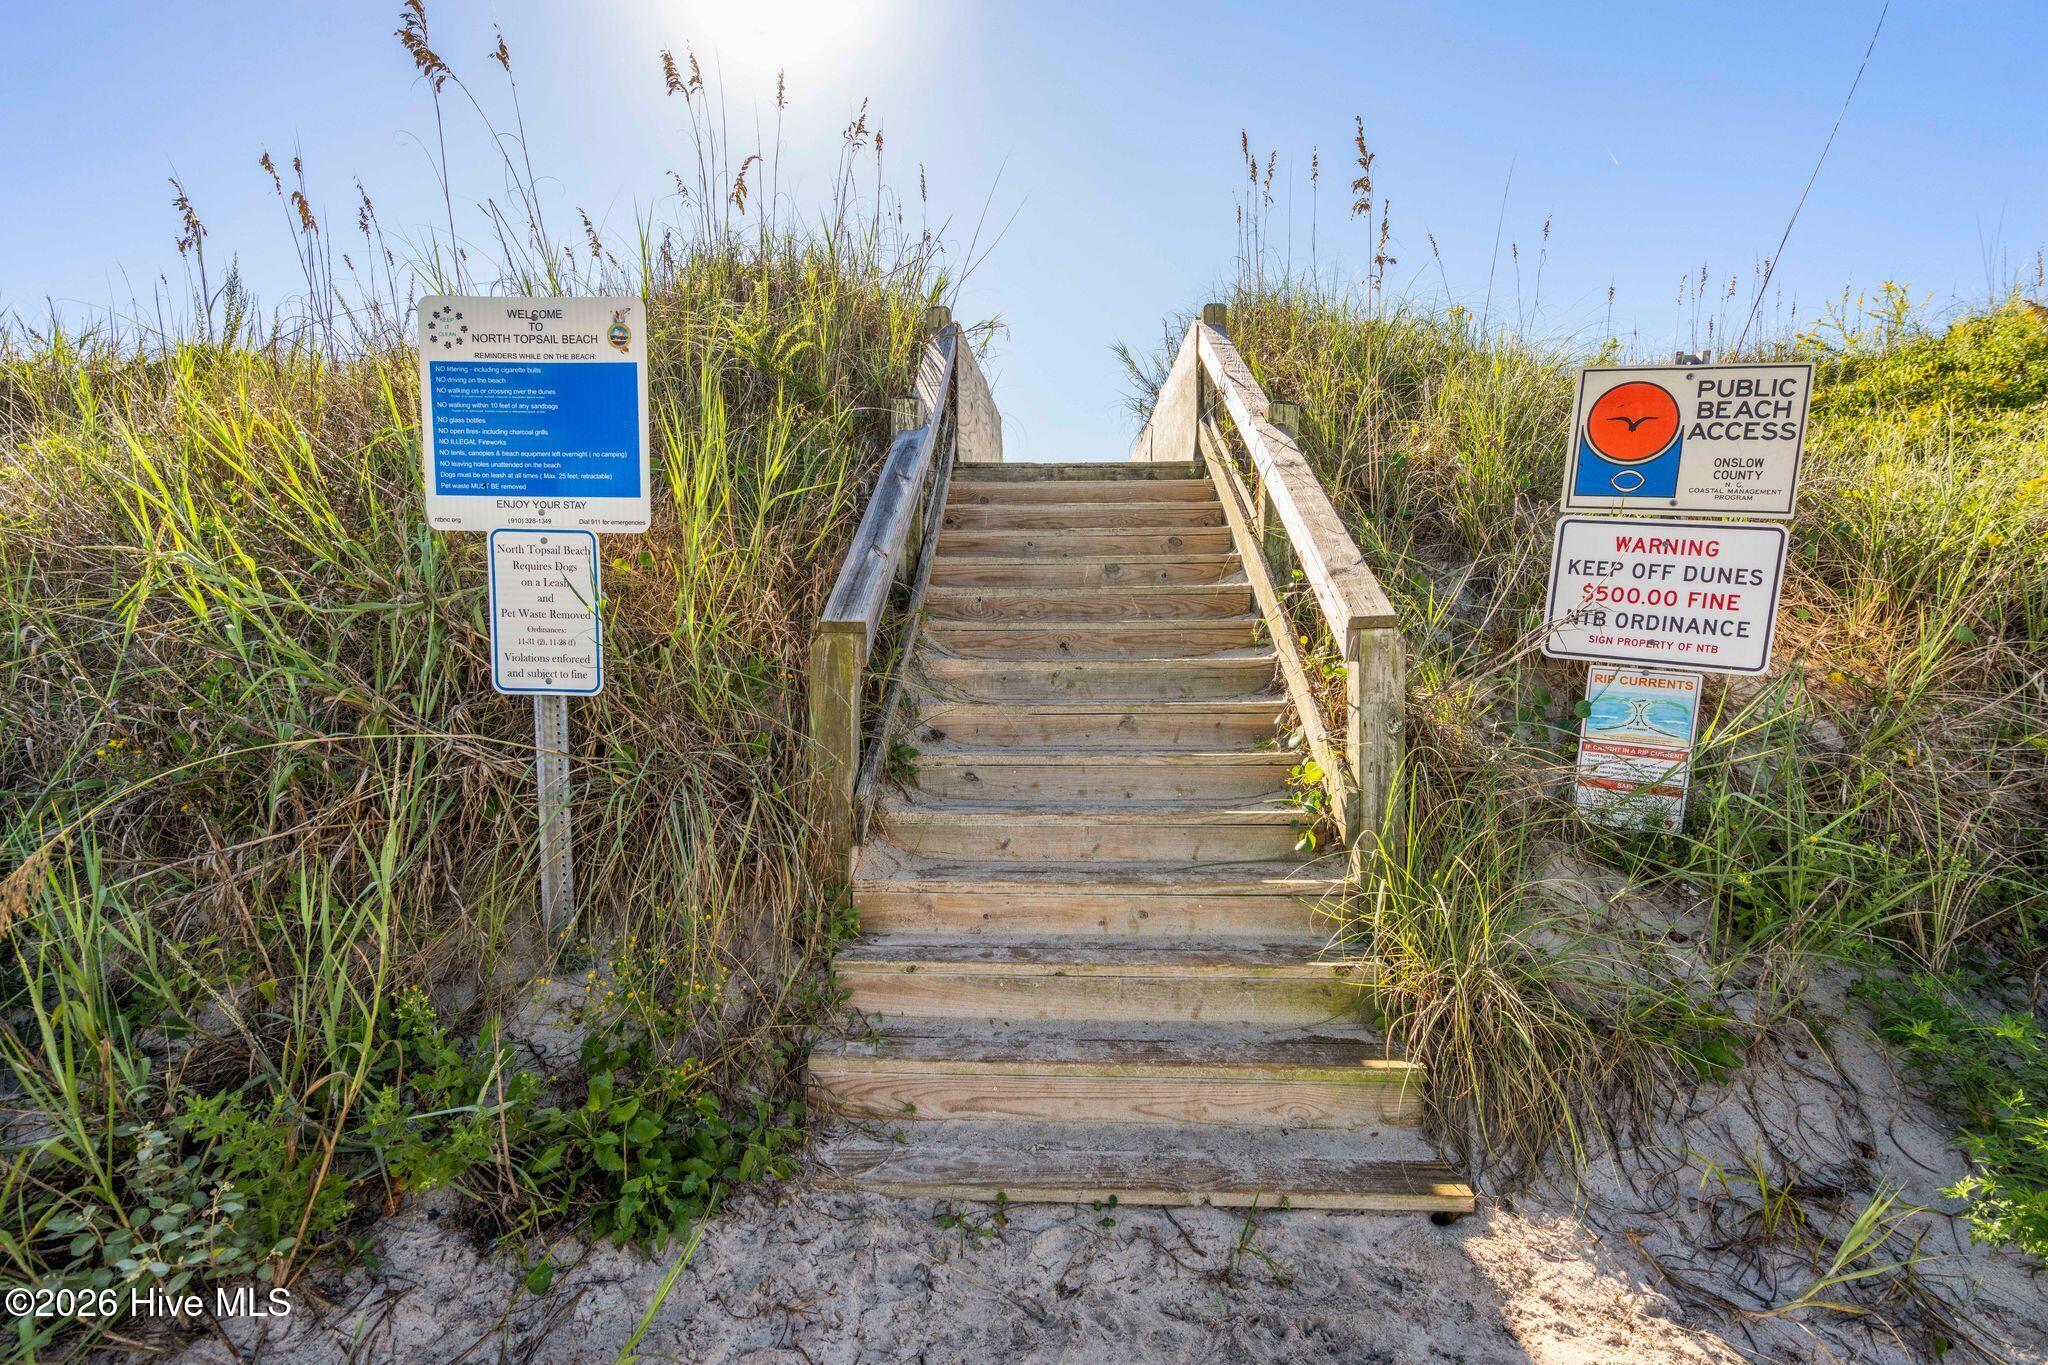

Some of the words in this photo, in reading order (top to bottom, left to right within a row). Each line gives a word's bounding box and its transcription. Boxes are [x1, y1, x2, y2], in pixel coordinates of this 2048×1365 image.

[507, 309, 562, 320] WELCOME
[529, 322, 543, 331] TO
[472, 333, 511, 343] NORTH
[513, 334, 559, 344] TOPSAIL
[562, 334, 598, 344] BEACH
[474, 352, 518, 360] REMINDERS
[474, 366, 500, 374] including
[1697, 378, 1797, 398] PUBLIC
[449, 402, 470, 410] walking
[1697, 401, 1792, 419] BEACH
[1687, 422, 1797, 441] ACCESS
[1714, 457, 1764, 468] ONSLOW
[1713, 470, 1763, 480] COUNTY
[496, 500, 530, 508] ENJOY
[533, 501, 560, 509] YOUR
[563, 501, 586, 509] STAY
[497, 544, 524, 554] North
[527, 545, 560, 556] Topsail
[564, 545, 591, 556] Beach
[1616, 536, 1720, 557] WARNING
[513, 561, 552, 572] Requires
[555, 562, 577, 572] Dogs
[1568, 559, 1624, 577] KEEP
[1632, 563, 1675, 580] OFF
[1683, 566, 1763, 586] DUNES
[544, 578, 568, 587] Leash
[538, 594, 554, 603] and
[1582, 582, 1678, 607] $500.00
[1688, 592, 1741, 611] FINE
[501, 609, 515, 618] Pet
[518, 609, 546, 619] Waste
[550, 610, 591, 620] Removed
[527, 626, 566, 634] Ordinances:
[1615, 612, 1751, 638] ORDINANCE
[1588, 635, 1613, 645] SIGN
[1617, 637, 1674, 650] PROPERTY
[1678, 643, 1693, 652] OF
[1696, 644, 1718, 654] NTB
[504, 653, 549, 663] Violations
[552, 653, 590, 664] enforced
[507, 669, 524, 678] and
[527, 669, 557, 680] subject
[571, 670, 588, 679] fine
[1594, 674, 1616, 684] RIP
[1619, 675, 1694, 691] CURRENTS
[1651, 750, 1684, 759] CURRENT
